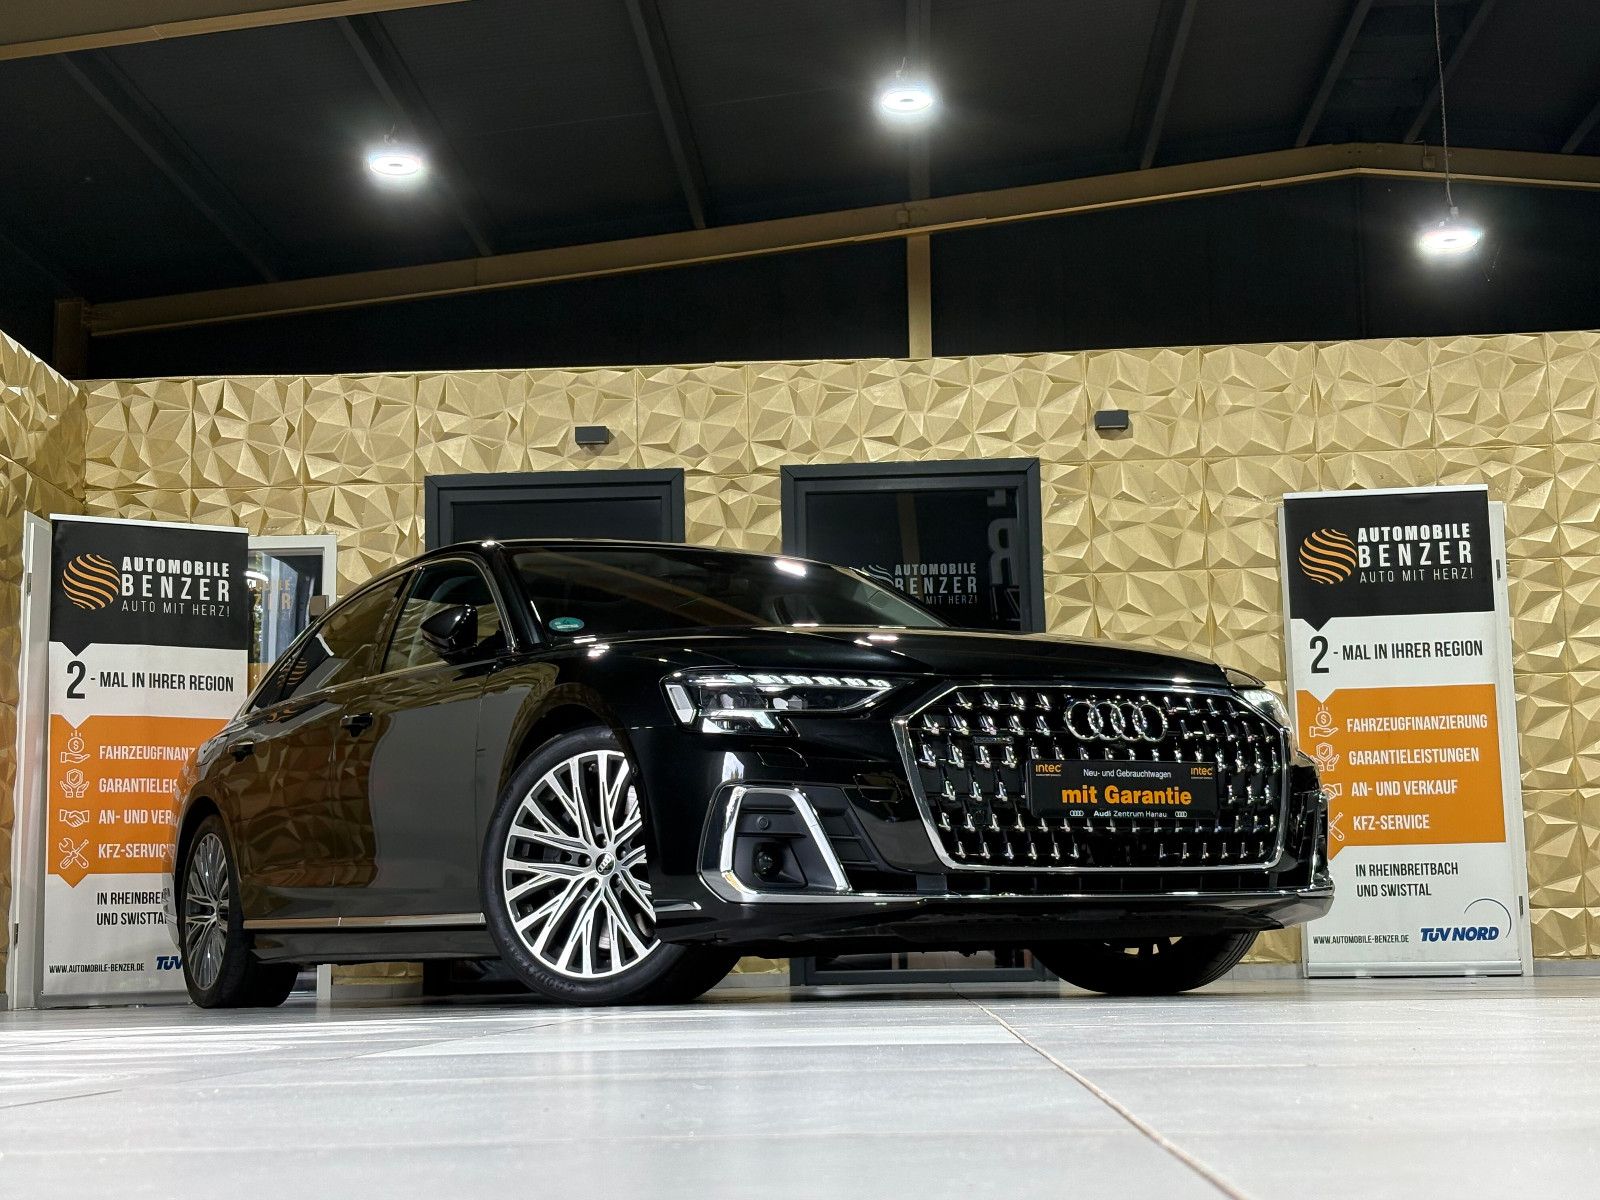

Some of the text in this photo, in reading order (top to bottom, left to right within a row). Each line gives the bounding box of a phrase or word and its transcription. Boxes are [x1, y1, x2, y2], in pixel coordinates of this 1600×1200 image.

[1357, 522, 1471, 543] AUTOMOBILE
[1357, 540, 1473, 569] BENZER
[121, 556, 230, 578] AUTOMOBILE
[894, 562, 977, 576] AUTOMOBILE
[1359, 566, 1474, 583] AUTO MIT HERZ!
[121, 573, 231, 603] BENZER
[121, 599, 231, 618] AUTO MIT HERZ!
[926, 595, 943, 606] MIT
[1309, 635, 1330, 674] 2
[1342, 644, 1371, 661] MAL
[1374, 643, 1388, 660] IN
[1391, 642, 1432, 659] IHRER
[1434, 639, 1484, 658] REGION
[66, 660, 87, 700] 2
[99, 671, 129, 688] MAL
[131, 672, 146, 688] IN
[149, 672, 187, 690] IHRER
[189, 674, 235, 692] REGION
[1346, 713, 1489, 733] FAHRZEUGFINANZIERUNG
[1348, 747, 1480, 766] GARANTIELEISTUNGEN
[1035, 763, 1063, 773] intec
[1083, 768, 1172, 779] Neu- und Gebrauchtwagen
[1190, 767, 1213, 776] intec
[1061, 784, 1192, 806] mit Garantie
[1351, 779, 1459, 797] AN- UND VERKAUF
[98, 809, 121, 825] AN-
[123, 809, 148, 824] UND
[1113, 810, 1145, 818] Zentrum
[1353, 814, 1431, 831] KFZ-SERVICE
[1355, 862, 1459, 877] IN RHEINBREITBACH
[97, 892, 108, 905] IN
[1356, 883, 1432, 897] UND SWISTTAL
[96, 912, 118, 926] UND
[1313, 926, 1500, 945] WWW.AUTOMOBILE-BENZER.DE TÜV NORD
[49, 962, 145, 974] WWW.AUTOMOBILE-BENZER.DE
